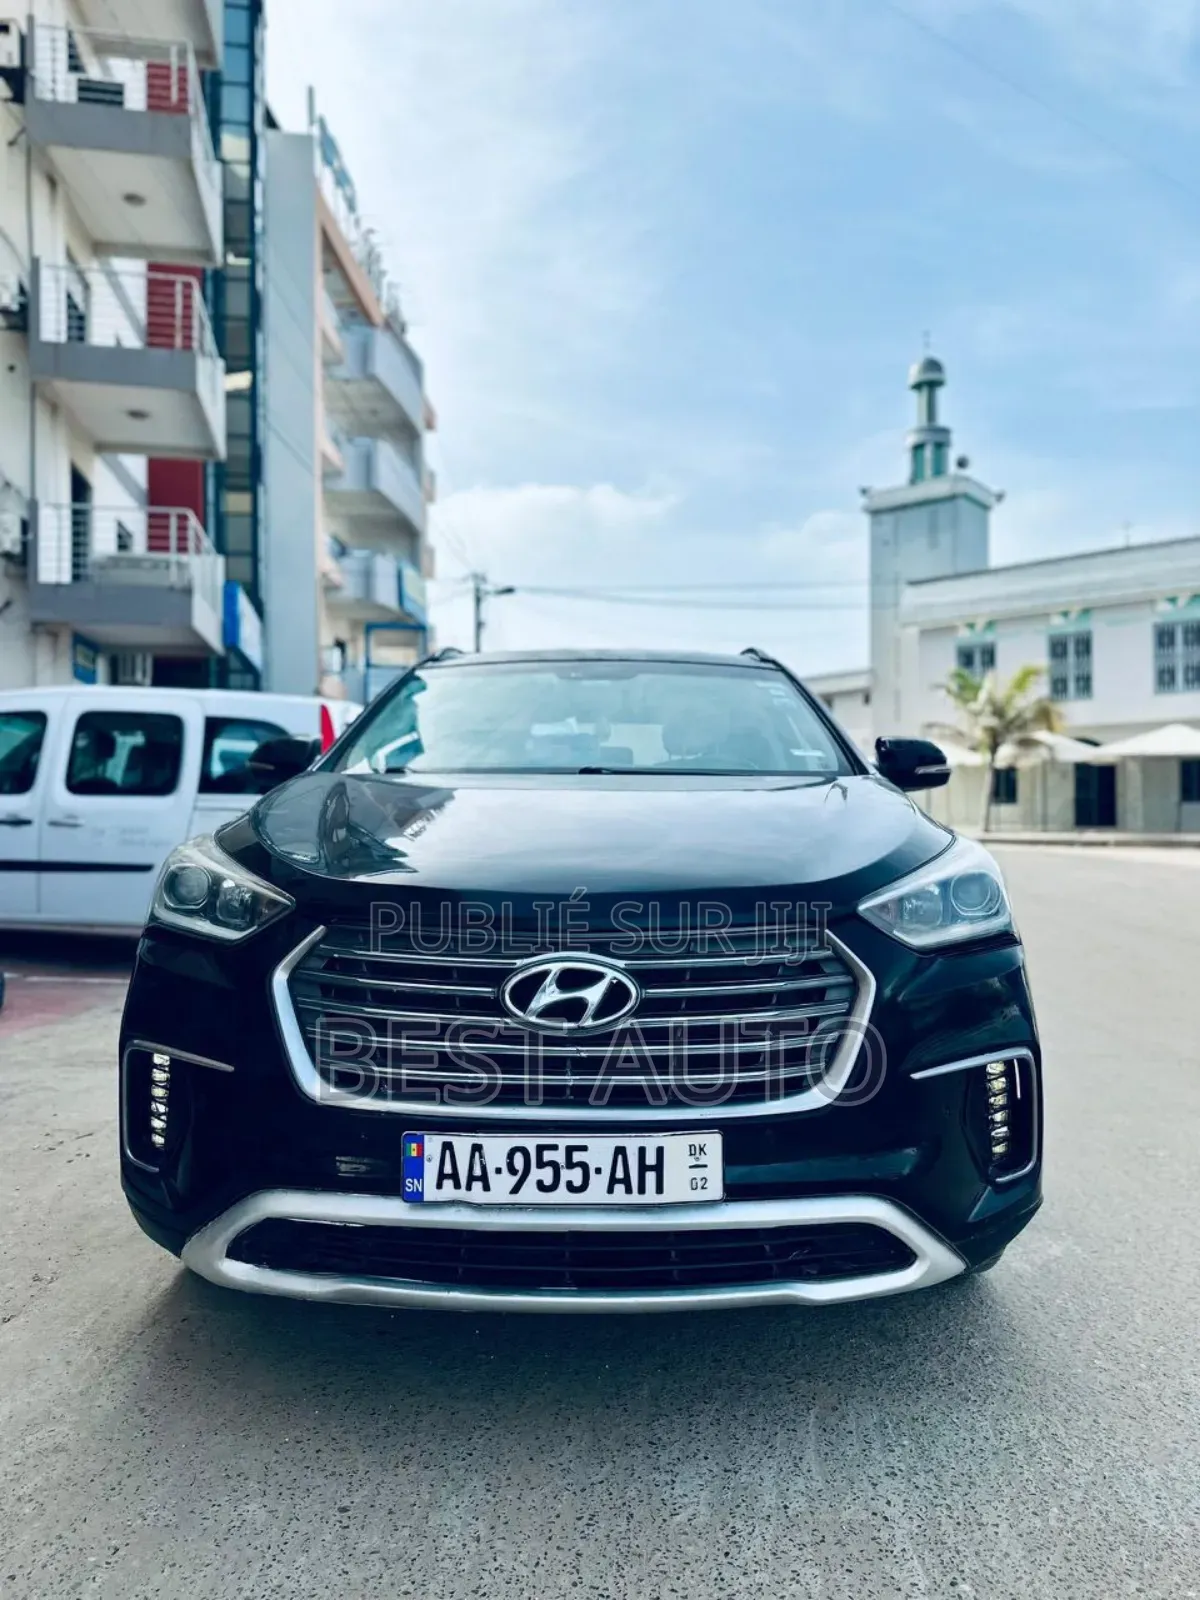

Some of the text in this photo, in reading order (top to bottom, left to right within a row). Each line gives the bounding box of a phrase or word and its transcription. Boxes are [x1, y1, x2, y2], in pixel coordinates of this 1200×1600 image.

[688, 1143, 707, 1157] DK
[405, 1178, 422, 1192] SN
[690, 1176, 708, 1191] 02
